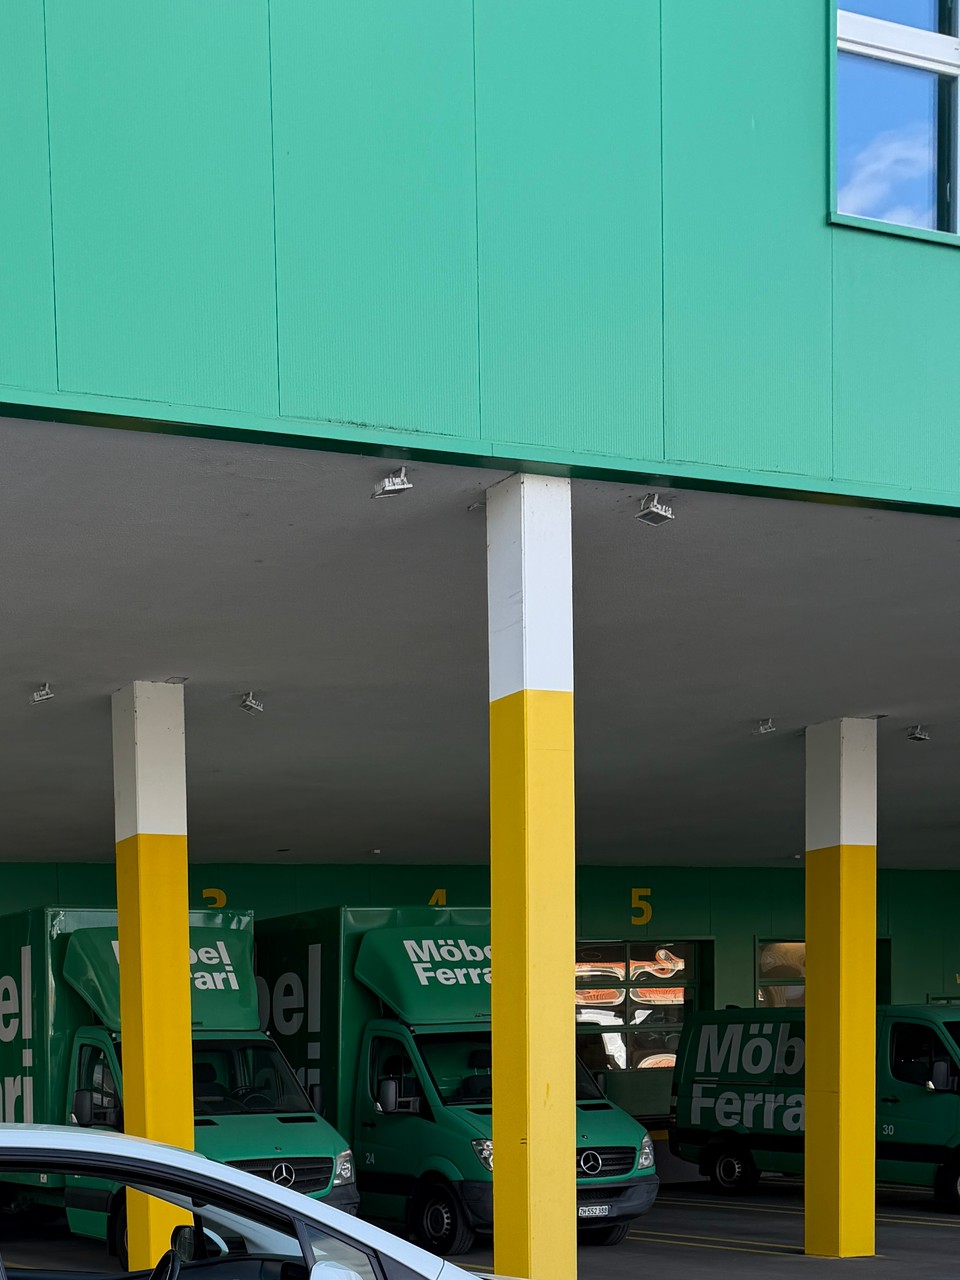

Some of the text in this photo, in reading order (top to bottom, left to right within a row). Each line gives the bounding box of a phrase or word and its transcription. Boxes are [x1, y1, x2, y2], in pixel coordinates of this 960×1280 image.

[631, 888, 653, 926] 5
[882, 1124, 895, 1136] 30
[365, 1152, 375, 1165] 24
